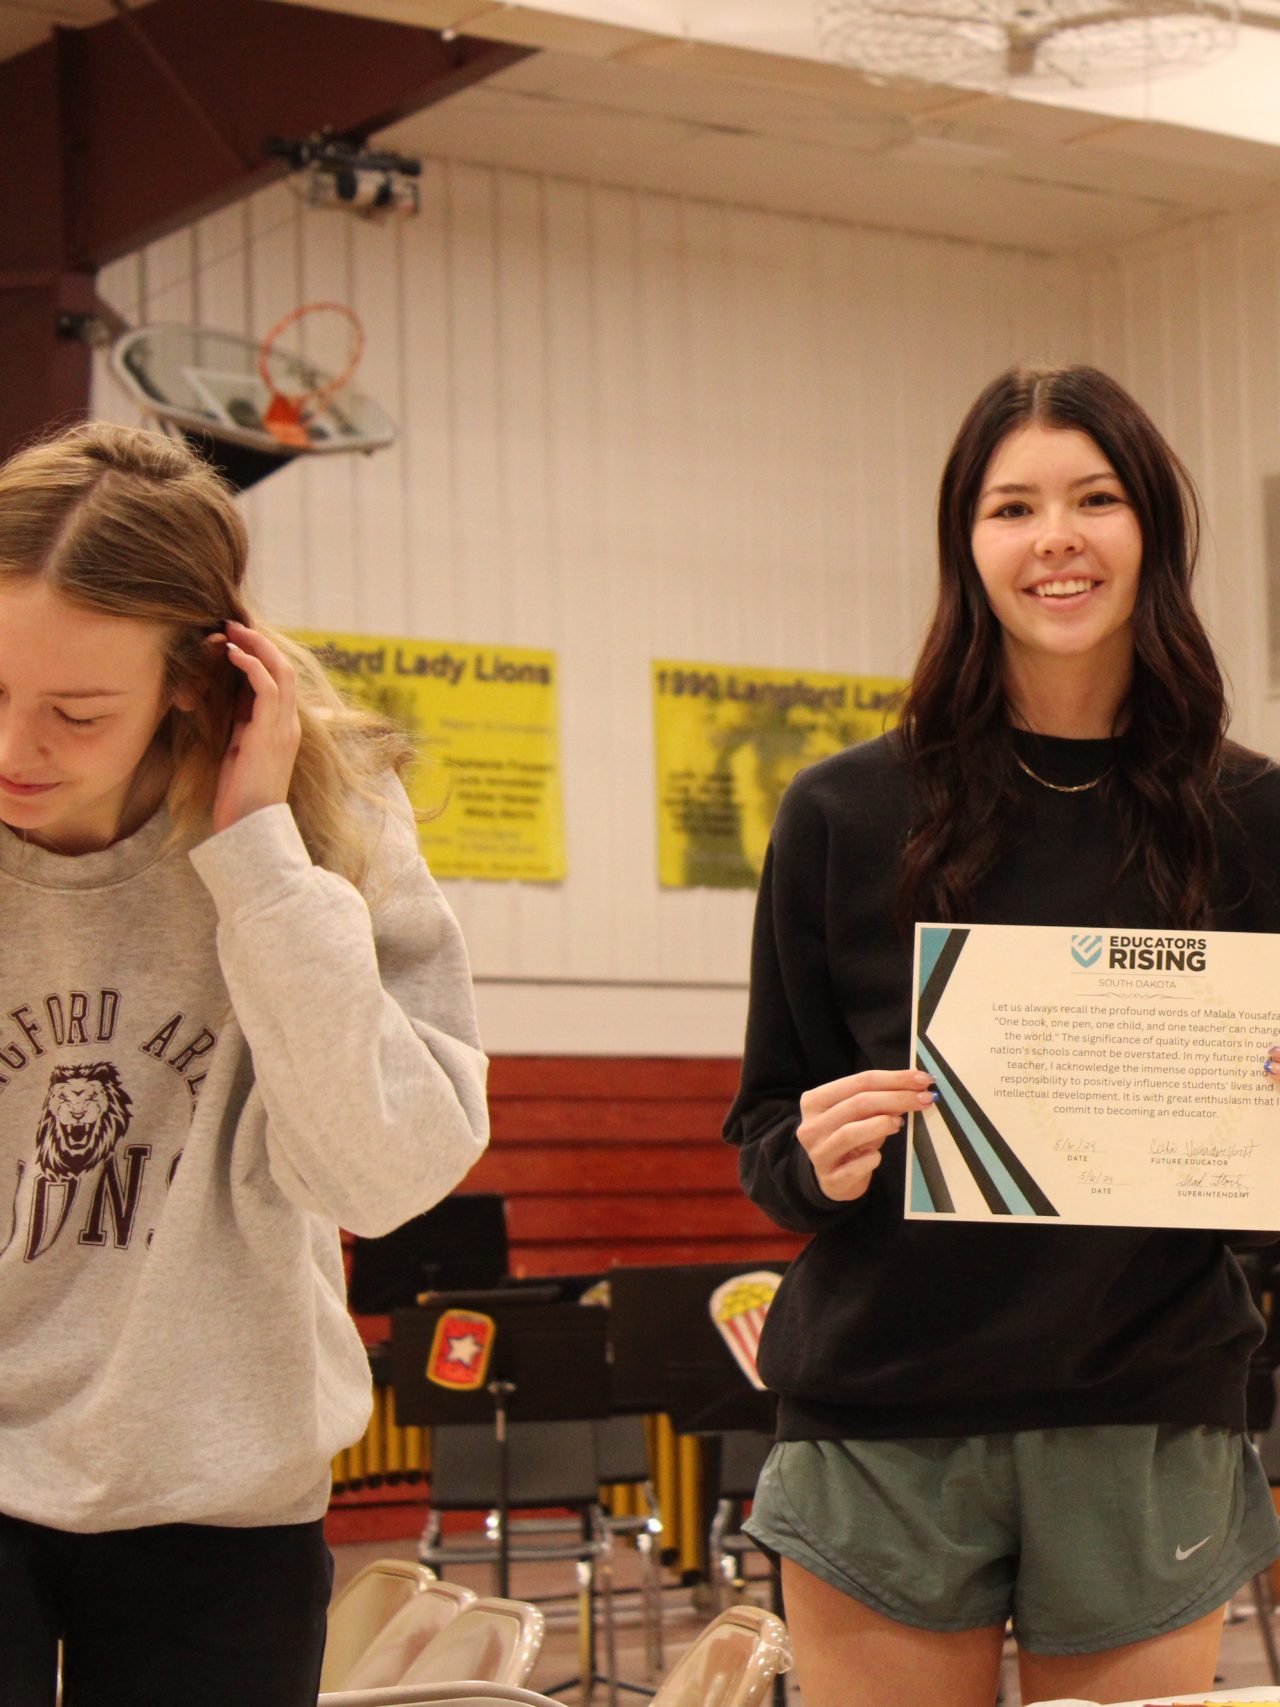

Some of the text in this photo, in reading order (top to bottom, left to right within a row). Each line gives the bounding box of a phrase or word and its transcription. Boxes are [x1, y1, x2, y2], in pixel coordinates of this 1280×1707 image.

[395, 647, 465, 687] Lady
[474, 654, 549, 685] Lions
[1110, 936, 1206, 950] EDUCATORS
[1109, 949, 1206, 971] RISING
[1099, 979, 1176, 988] SOUTH DAKOTA
[992, 1003, 1008, 1012] Let
[1024, 1004, 1057, 1015] always
[1061, 1006, 1087, 1014] recall
[1091, 1006, 1106, 1014] the
[1109, 1005, 1155, 1017] profound
[1159, 1008, 1188, 1017] words
[1191, 1009, 1200, 1017] of
[1204, 1009, 1235, 1019] Malala
[995, 1017, 1019, 1026] "One
[1022, 1018, 1048, 1028] book,
[1072, 1021, 1093, 1029] pen,
[1117, 1021, 1144, 1031] child,
[1147, 1022, 1165, 1031] and
[1189, 1024, 1225, 1032] teacher
[0, 988, 120, 1085] GFORD
[1005, 1031, 1021, 1040] the
[1062, 1033, 1079, 1042] The
[1082, 1034, 1140, 1045] significance
[1143, 1036, 1154, 1044] of
[1156, 1037, 1189, 1047] quality
[1193, 1038, 1241, 1047] educators
[990, 1046, 1029, 1055] nation's
[1032, 1048, 1069, 1056] schools
[1072, 1049, 1106, 1057] cannot
[1109, 1050, 1121, 1058] be
[1124, 1050, 1180, 1060] overstated.
[1195, 1054, 1209, 1063] my
[1213, 1053, 1243, 1062] future
[1246, 1054, 1264, 1062] role
[1007, 1061, 1047, 1071] teacher,
[1056, 1062, 1119, 1073] acknowledge
[1123, 1064, 1138, 1072] the
[1142, 1065, 1185, 1073] immense
[1188, 1067, 1247, 1078] opportunity
[1001, 1075, 1273, 1091] responsibility to positively influence students' lives and
[994, 1088, 1049, 1098] intellectual
[1052, 1090, 1119, 1102] development.
[1143, 1093, 1163, 1102] with
[1167, 1094, 1191, 1104] great
[1195, 1095, 1250, 1105] enthusiasm
[1254, 1097, 1274, 1105] that
[1054, 1105, 1090, 1114] commit
[1094, 1106, 1104, 1114] to
[1107, 1106, 1155, 1118] becoming
[1172, 1108, 1218, 1118] educator.
[1177, 1190, 1249, 1198] SUPERINTENDENT
